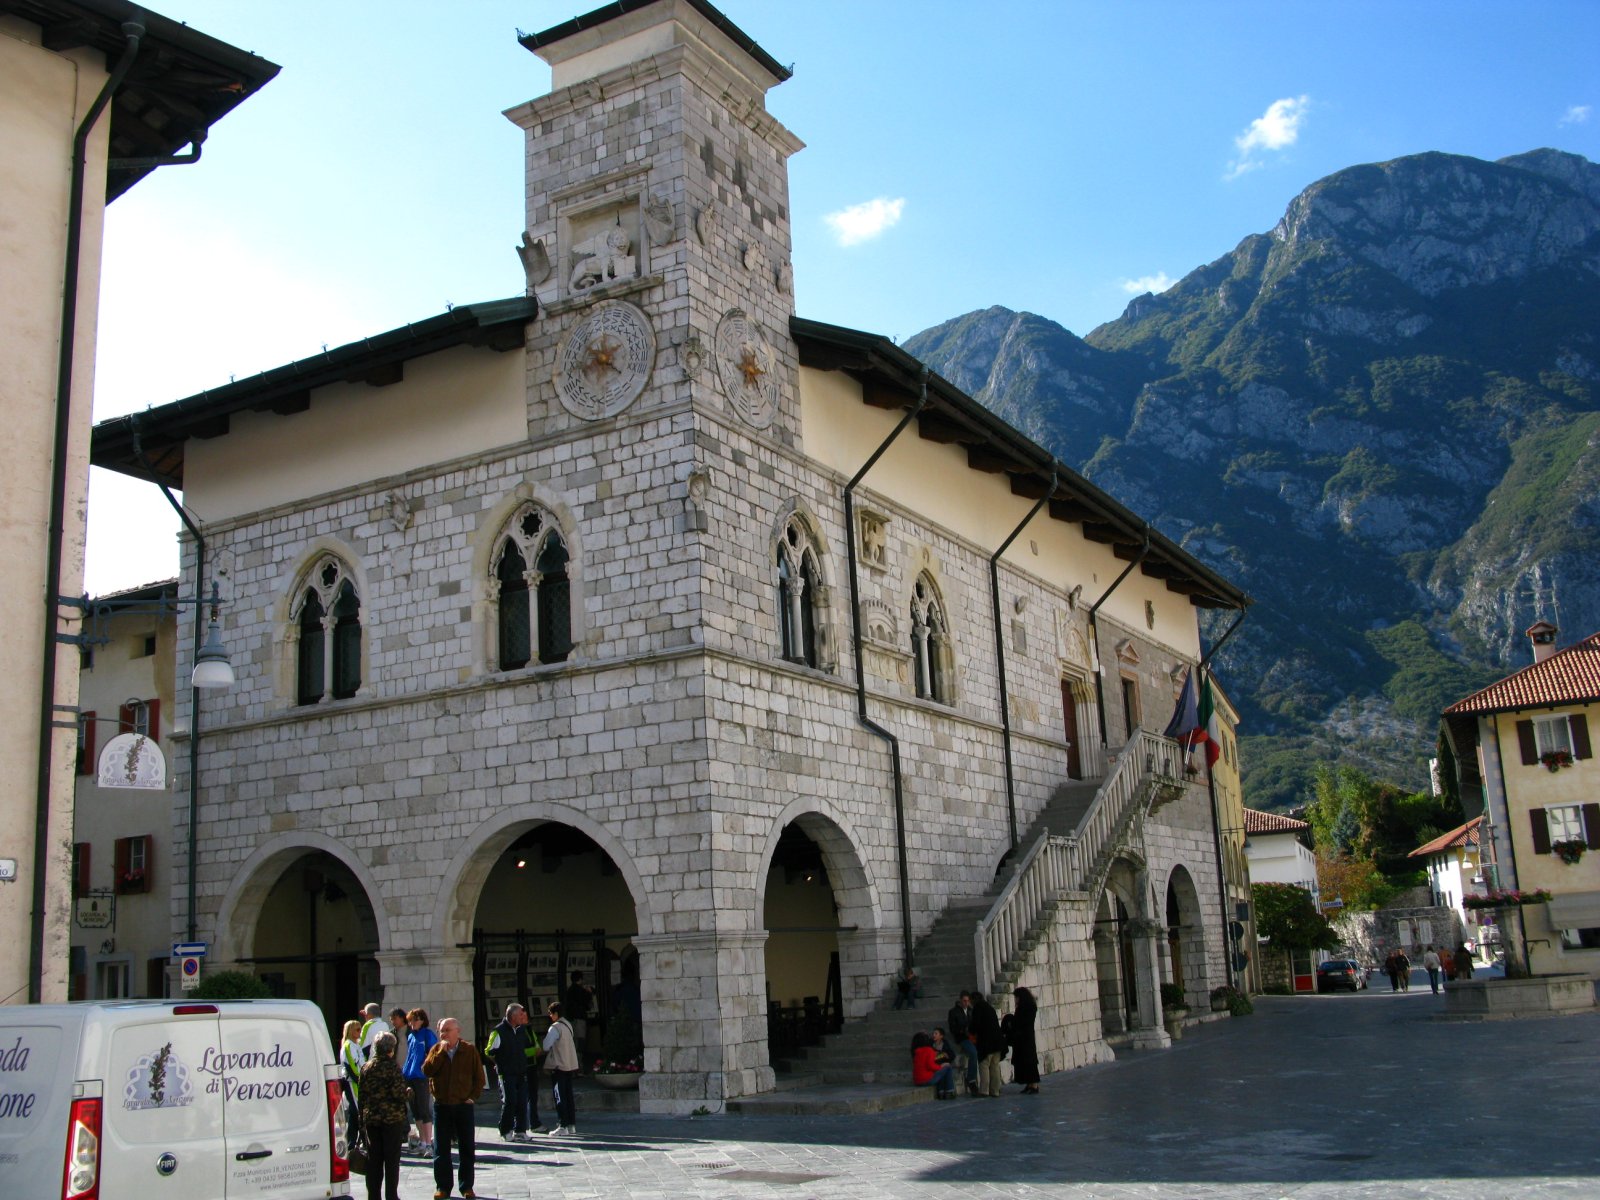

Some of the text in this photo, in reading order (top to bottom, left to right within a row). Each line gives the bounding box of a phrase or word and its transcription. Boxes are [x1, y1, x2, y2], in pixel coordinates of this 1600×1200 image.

[197, 1044, 293, 1075] Lavanda
[206, 1076, 311, 1102] di Venzone
[160, 1160, 175, 1168] FIAT
